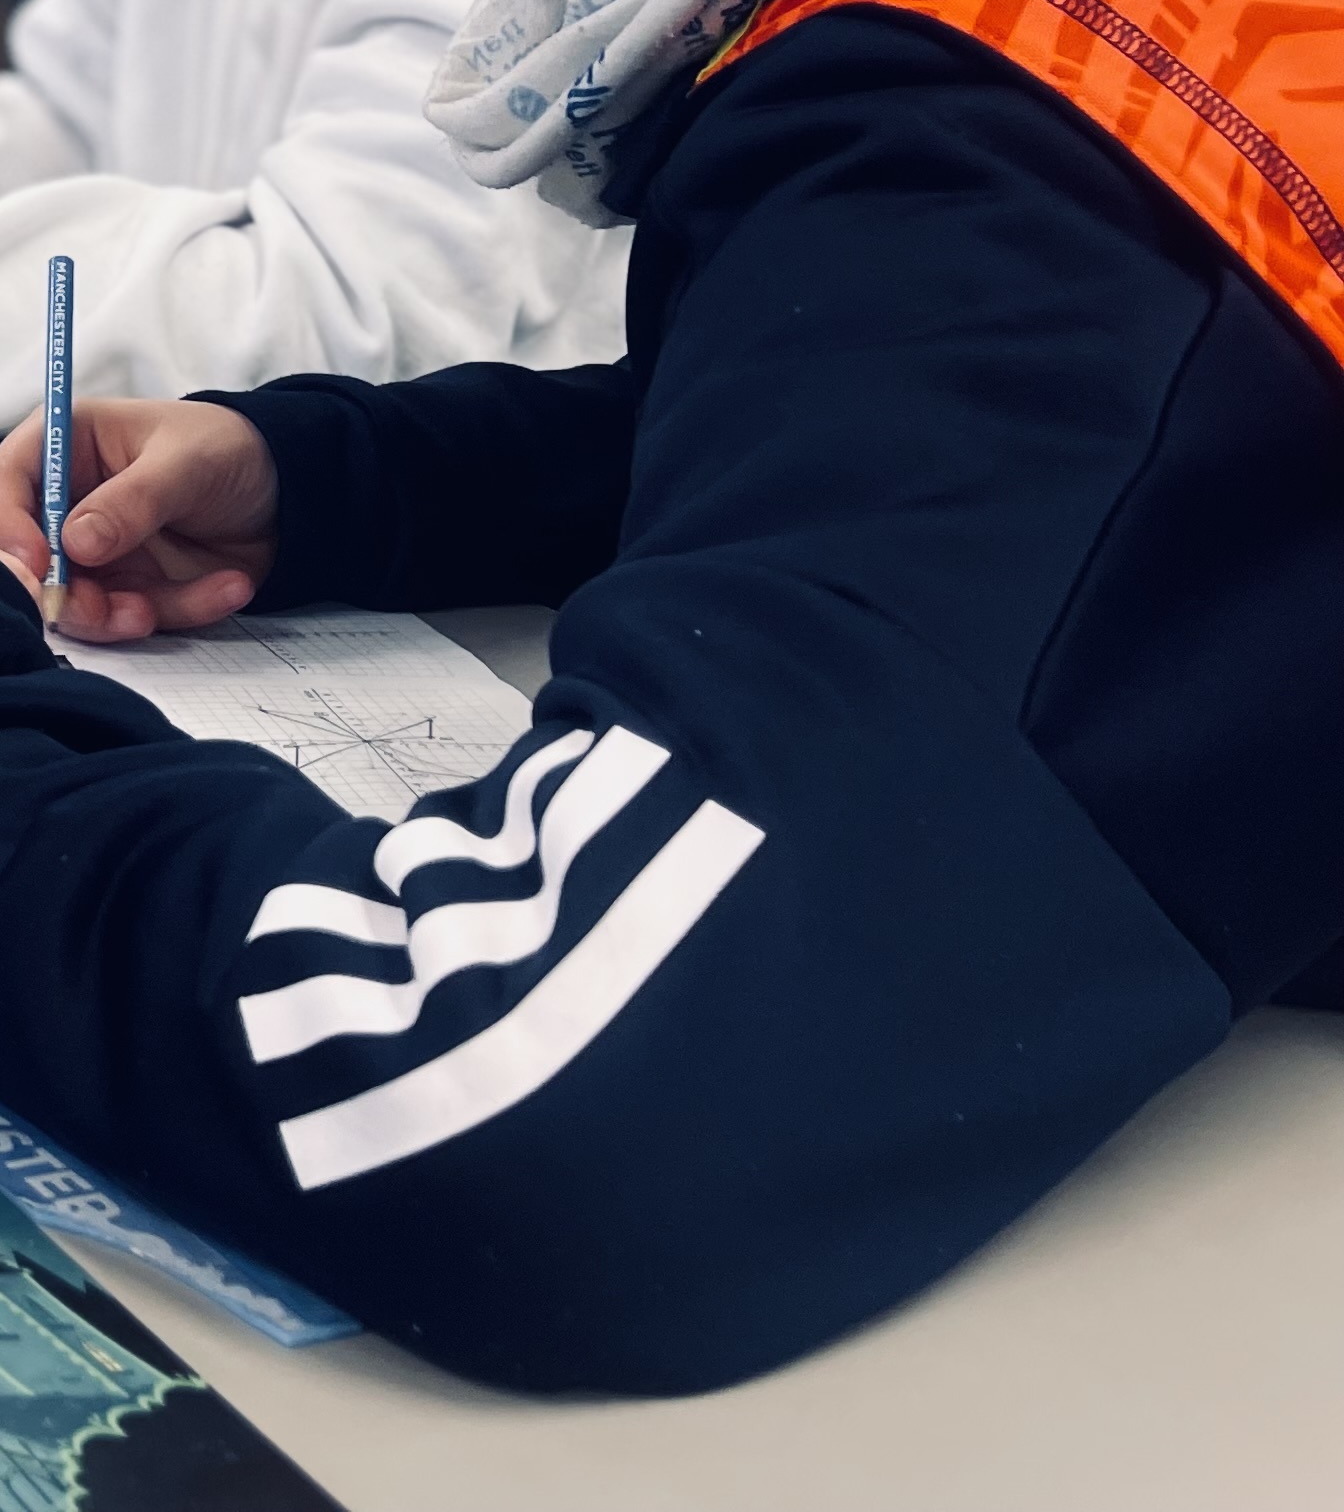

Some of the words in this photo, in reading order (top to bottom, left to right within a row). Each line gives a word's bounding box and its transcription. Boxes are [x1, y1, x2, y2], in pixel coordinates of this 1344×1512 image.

[53, 259, 67, 357] MANCHESTER
[52, 358, 64, 394] CITY
[46, 508, 62, 550] Junior
